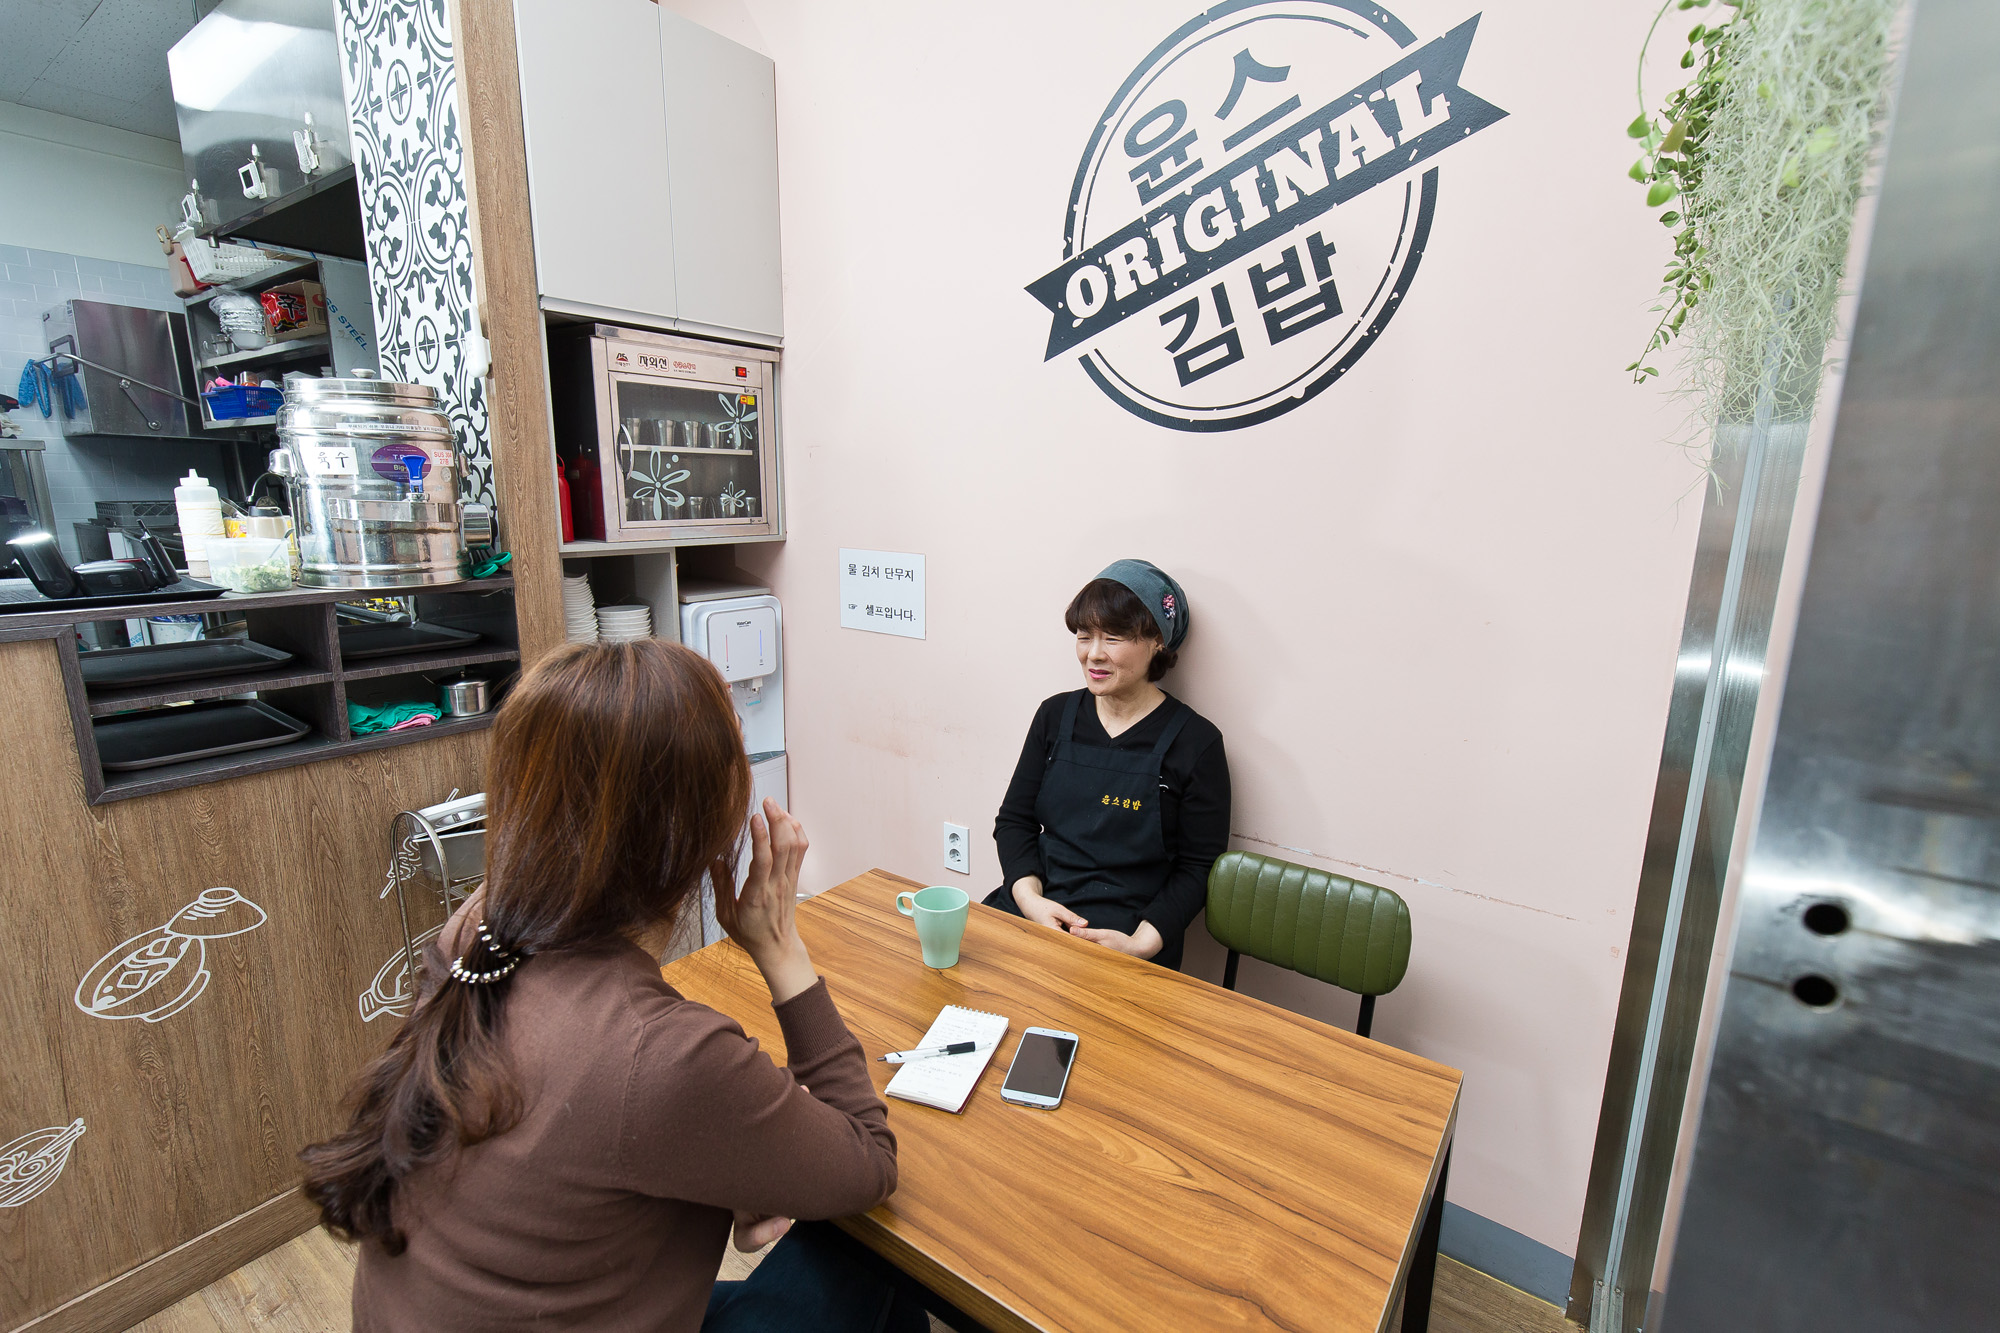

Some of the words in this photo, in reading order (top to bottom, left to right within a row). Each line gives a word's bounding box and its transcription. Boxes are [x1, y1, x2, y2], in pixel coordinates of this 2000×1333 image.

[1123, 47, 1302, 206] 윤스
[1065, 69, 1451, 319] ORIGINAL
[278, 294, 305, 320] 辛
[1159, 230, 1343, 388] 김밥
[338, 315, 368, 351] STEEL
[639, 355, 668, 370] 자외선
[848, 563, 857, 575] 물
[861, 565, 880, 578] 김치
[884, 567, 914, 582] 단무지
[865, 604, 916, 621] 셀프입니다.
